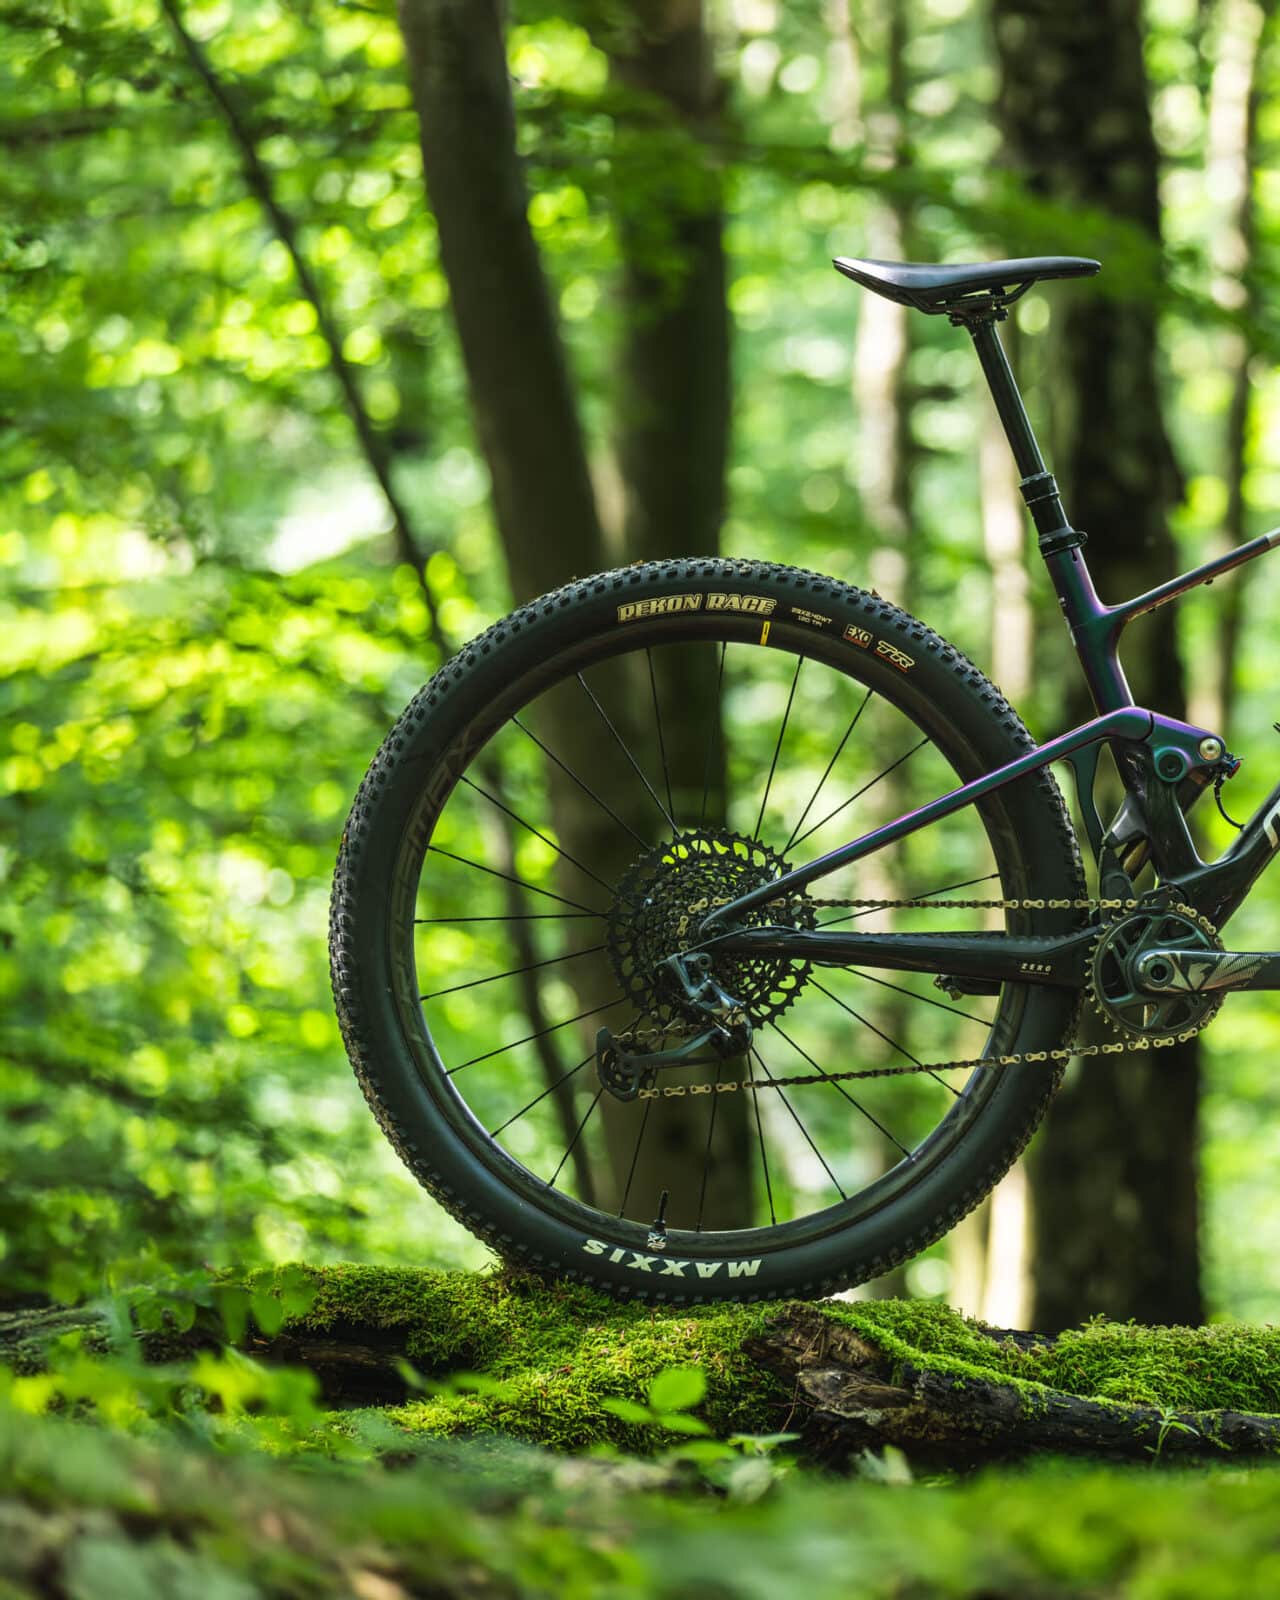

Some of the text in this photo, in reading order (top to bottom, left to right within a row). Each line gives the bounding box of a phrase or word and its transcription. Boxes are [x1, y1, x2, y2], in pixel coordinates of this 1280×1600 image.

[705, 592, 777, 616] RACE
[846, 625, 872, 643] EXO
[876, 640, 915, 669] TR
[1021, 962, 1052, 973] ZERO
[583, 1239, 762, 1277] MAXXIS
